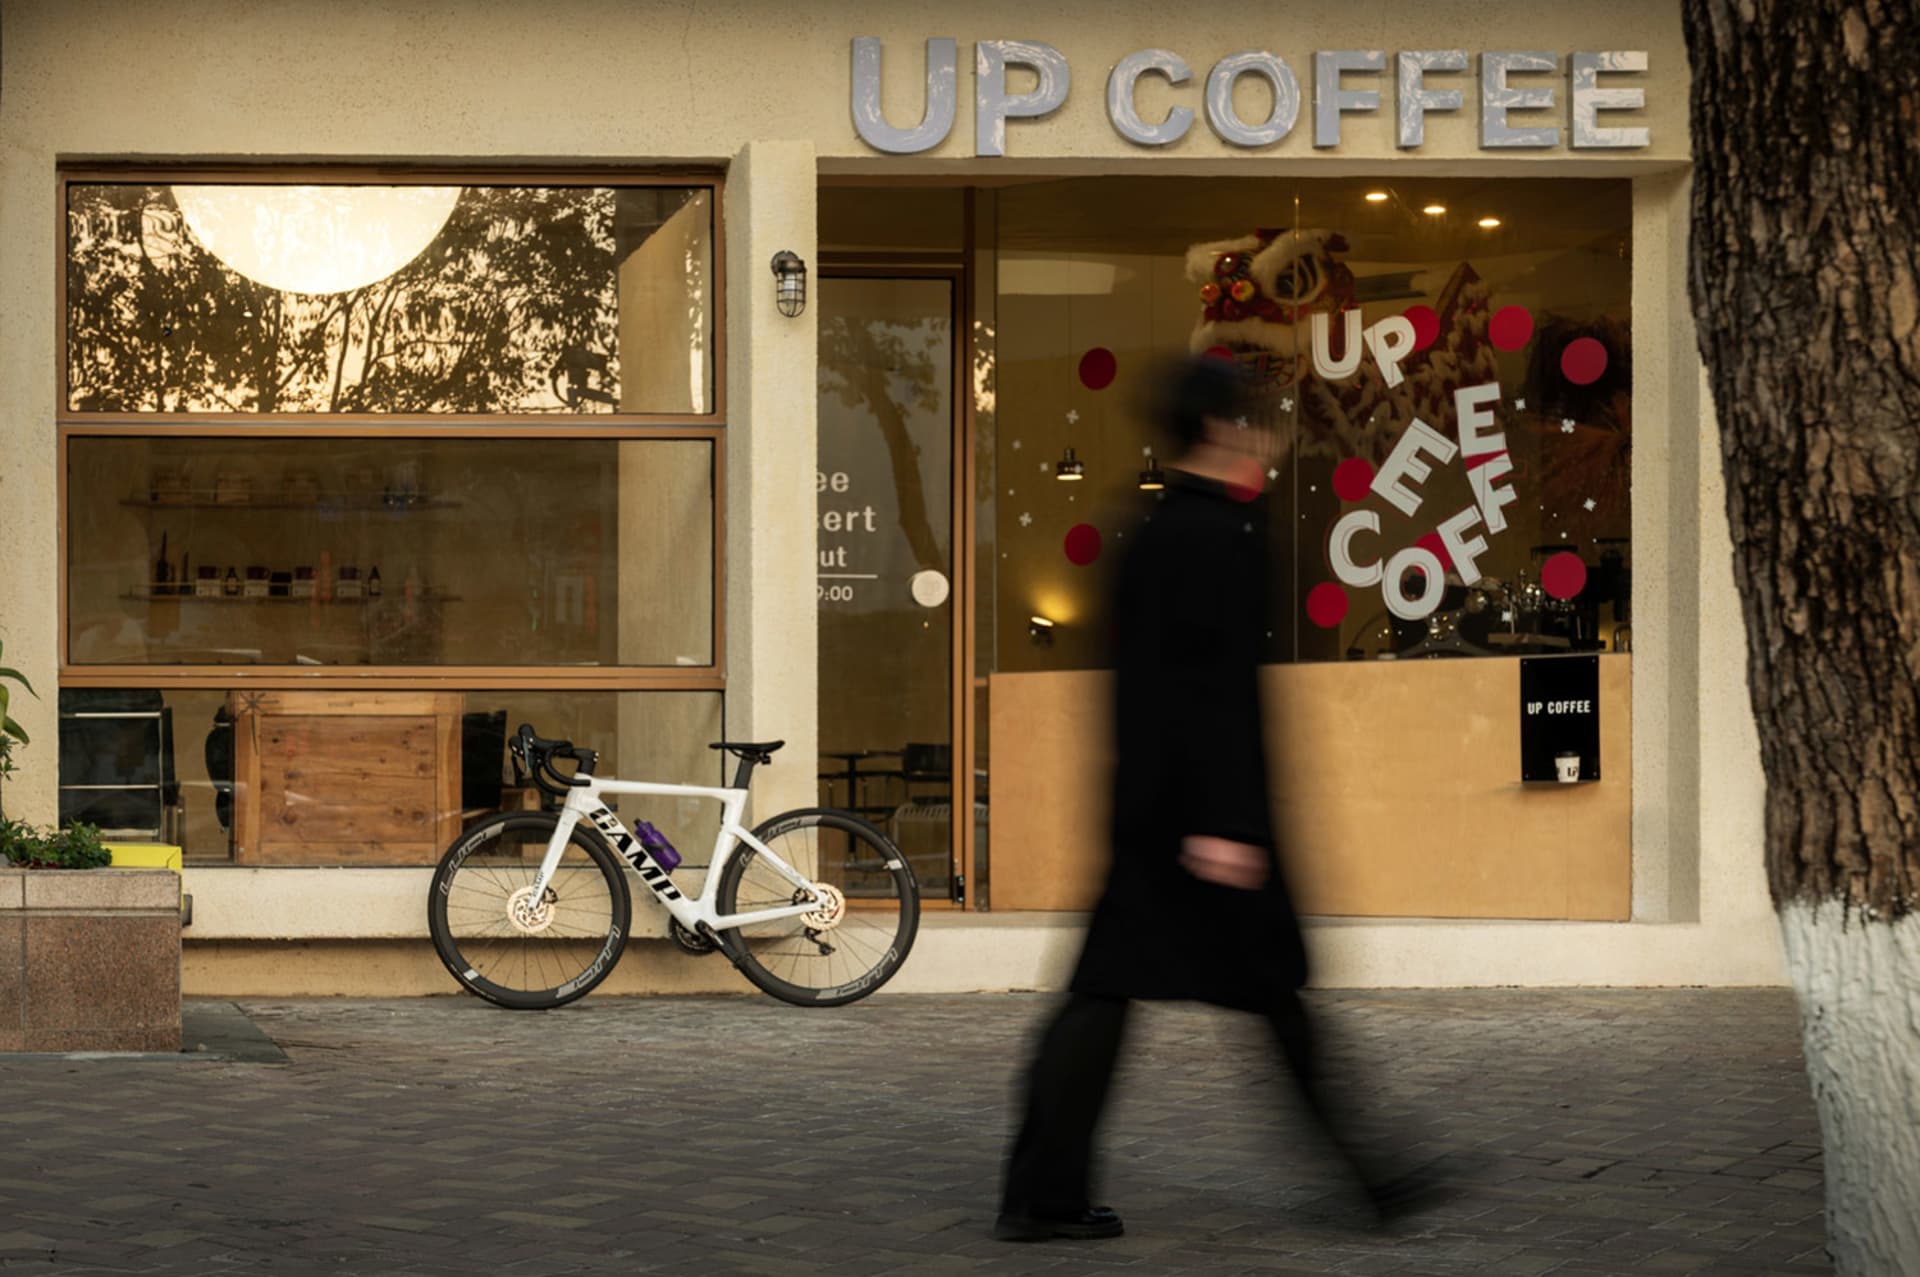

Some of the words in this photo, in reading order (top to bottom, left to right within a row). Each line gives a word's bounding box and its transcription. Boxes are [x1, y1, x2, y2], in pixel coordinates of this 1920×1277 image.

[851, 36, 1070, 156] UP
[1107, 48, 1650, 149] COFFEE
[1311, 308, 1416, 389] UP
[817, 505, 876, 532] ert
[1527, 701, 1543, 715] UP
[1547, 699, 1591, 715] COFFEE
